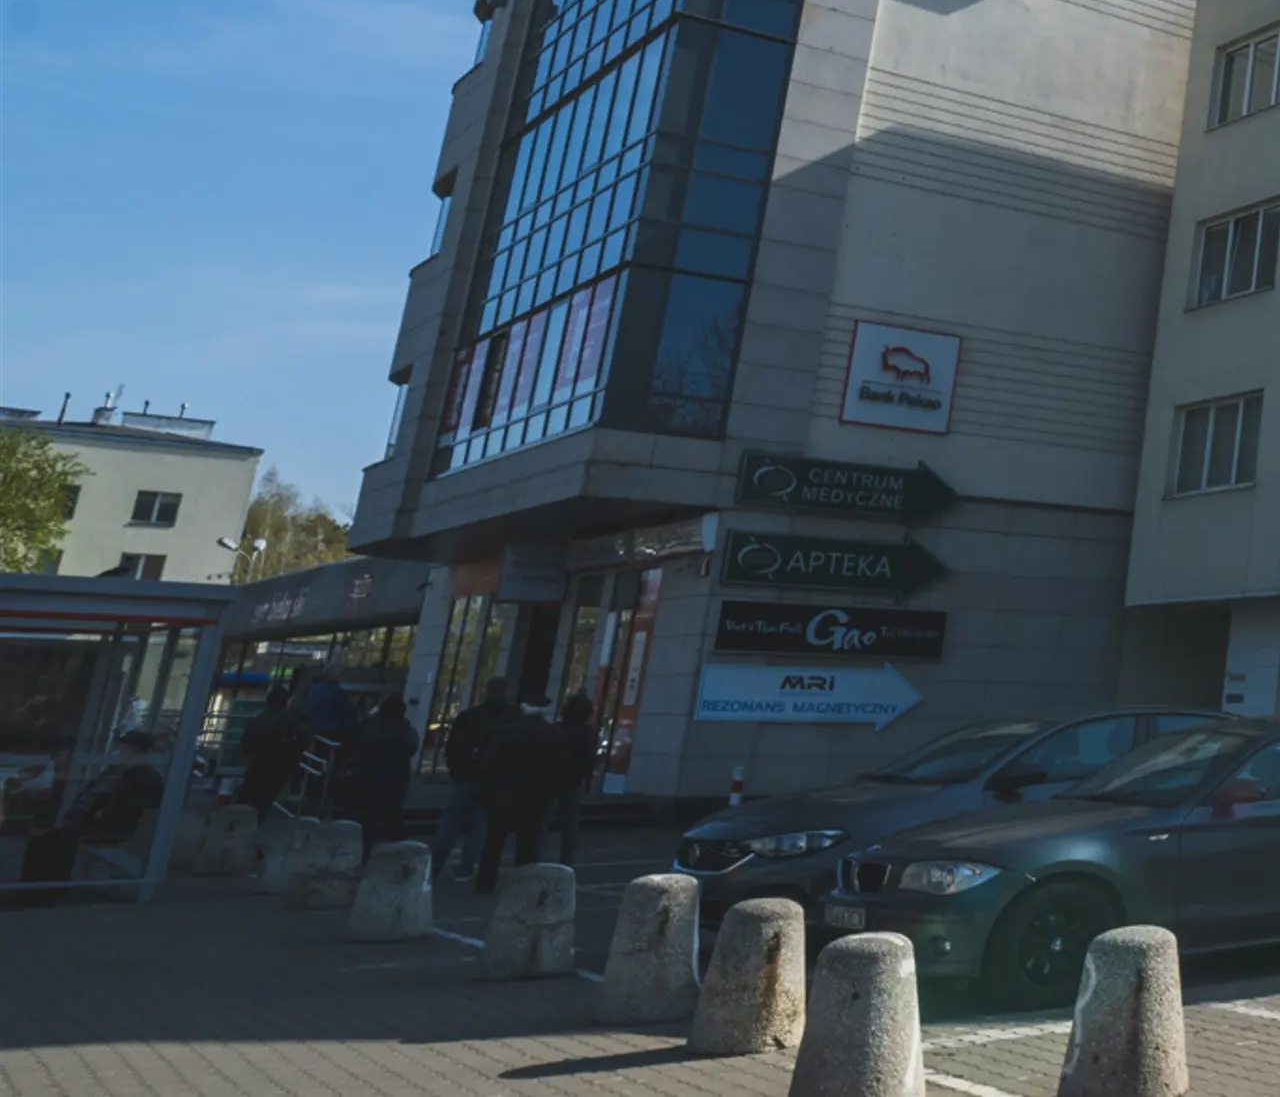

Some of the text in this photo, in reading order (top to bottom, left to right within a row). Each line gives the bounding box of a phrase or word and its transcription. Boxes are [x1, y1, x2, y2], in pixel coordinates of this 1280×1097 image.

[859, 385, 942, 410] Bank Pekao
[808, 467, 905, 491] CENTRUM
[801, 485, 904, 511] MEDYCZNE
[786, 549, 893, 579] APTEKA
[805, 609, 878, 651] Gao
[701, 699, 900, 715] REZONANS MAGNETYCZNY
